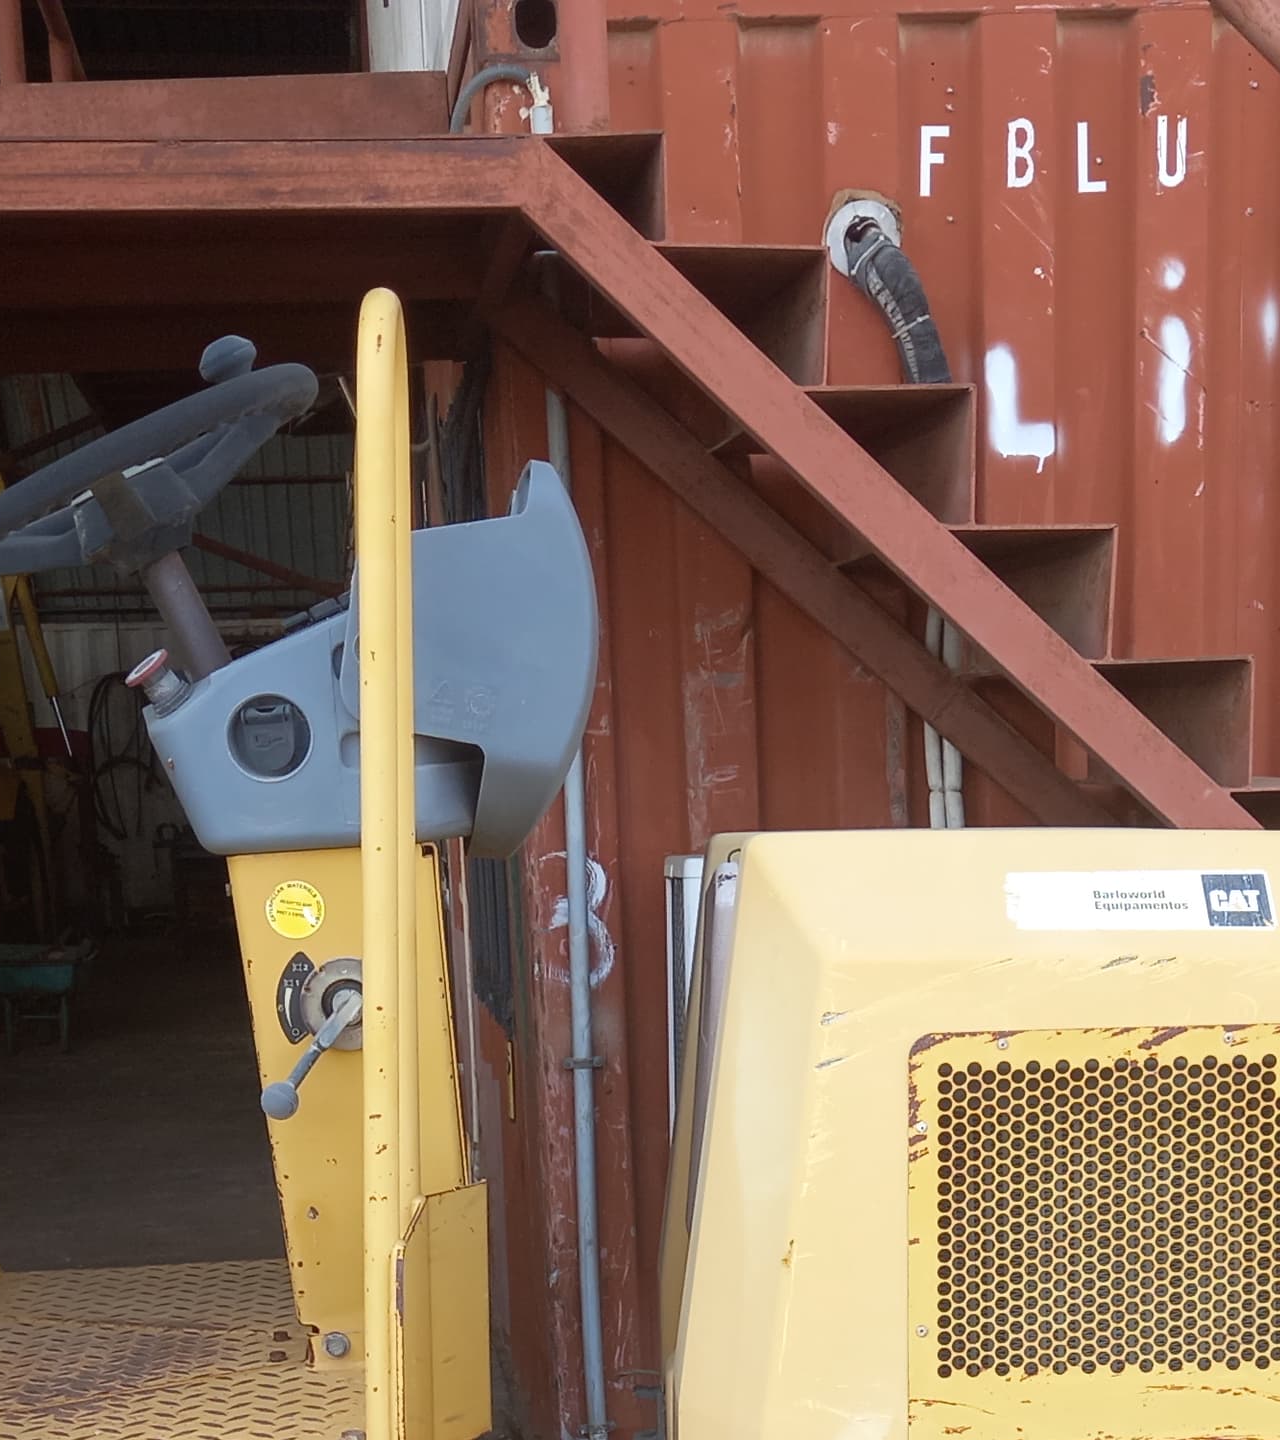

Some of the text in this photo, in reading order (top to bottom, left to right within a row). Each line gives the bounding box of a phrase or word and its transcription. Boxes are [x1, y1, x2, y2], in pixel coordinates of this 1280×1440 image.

[919, 114, 1187, 197] FBLU
[1092, 889, 1261, 913] Barloworld CAT
[1094, 900, 1190, 912] Equipamentos
